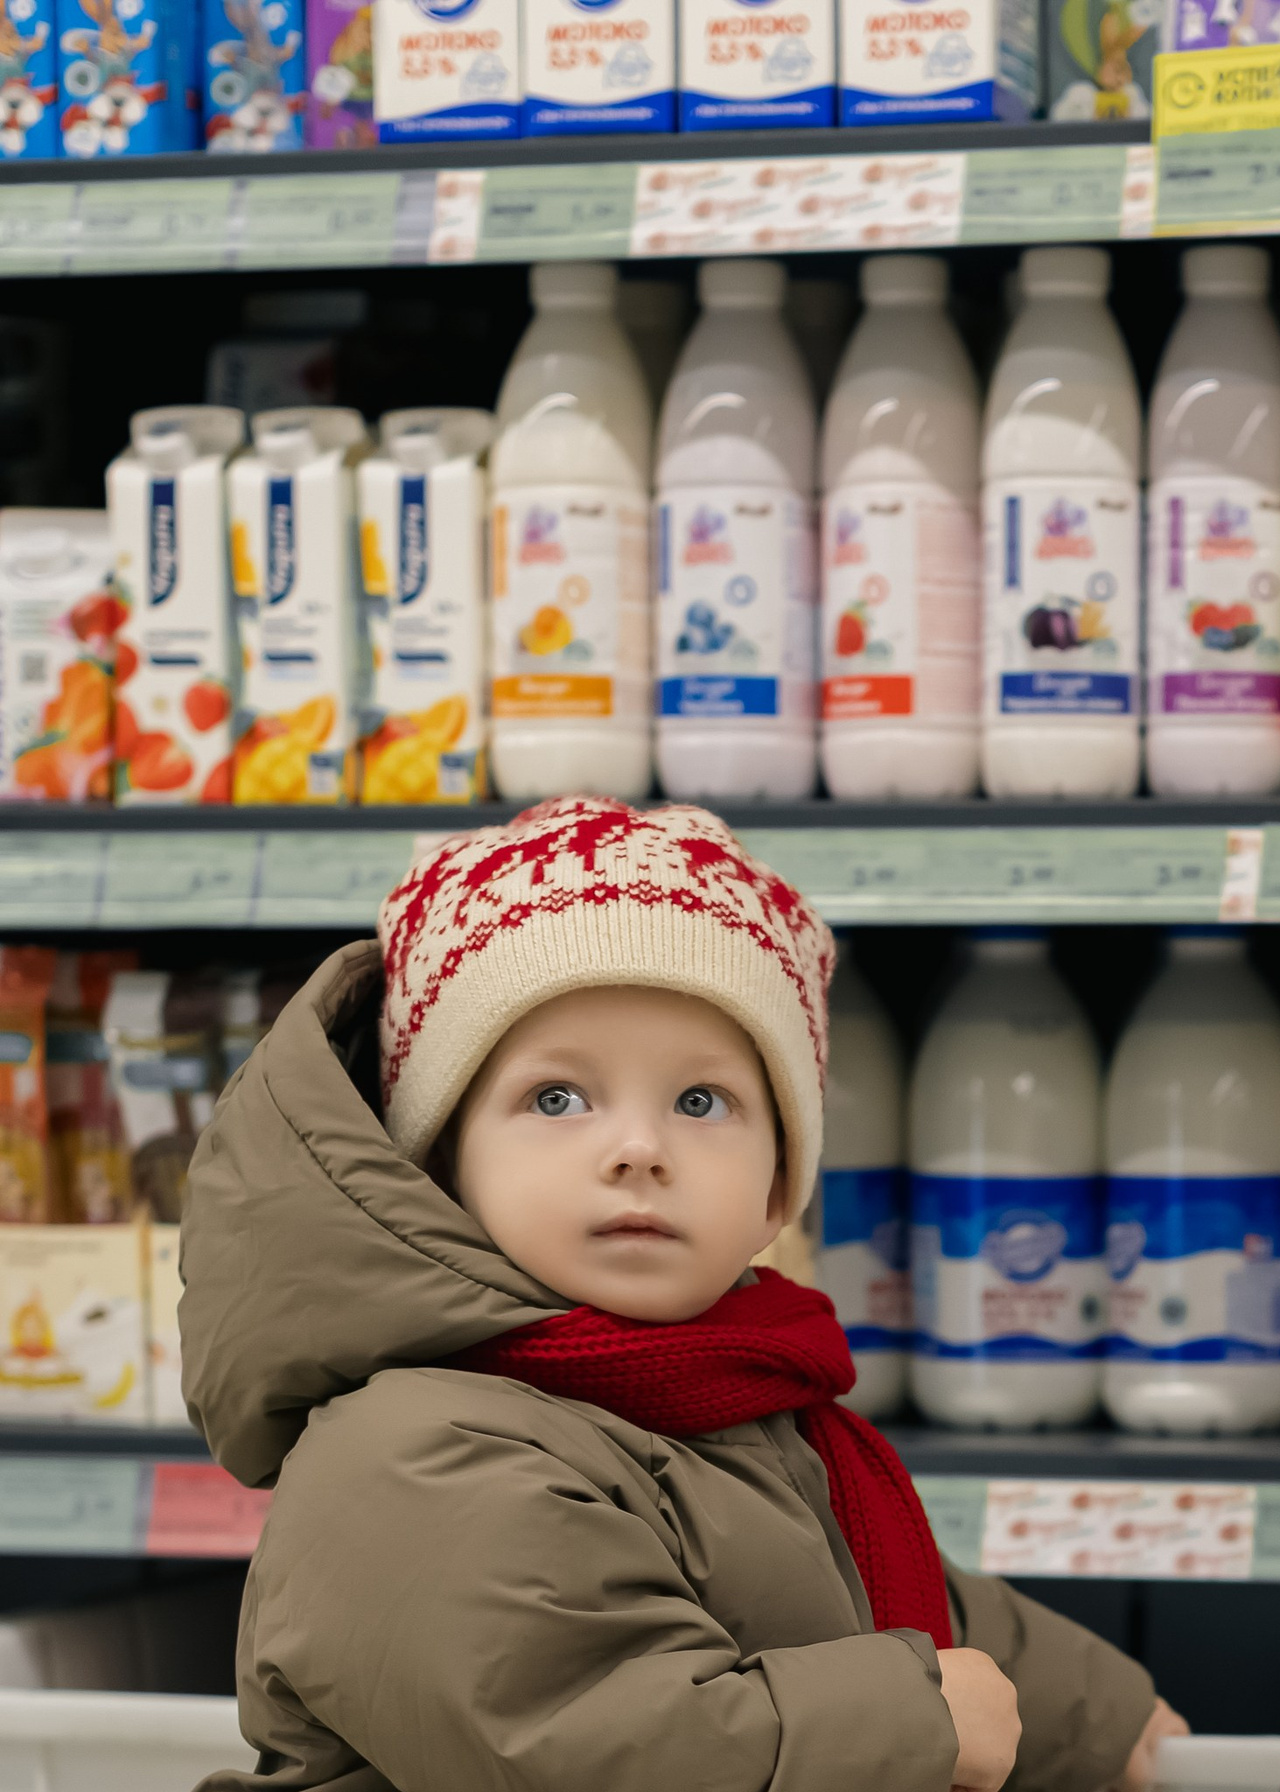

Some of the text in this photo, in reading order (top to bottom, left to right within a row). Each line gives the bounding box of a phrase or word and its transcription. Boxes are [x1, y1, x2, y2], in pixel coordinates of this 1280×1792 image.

[546, 19, 650, 43] МОЛОКО
[706, 13, 811, 36] МОЛОКО
[865, 9, 971, 34] МОЛОКО
[398, 29, 502, 52] МОЛОКО
